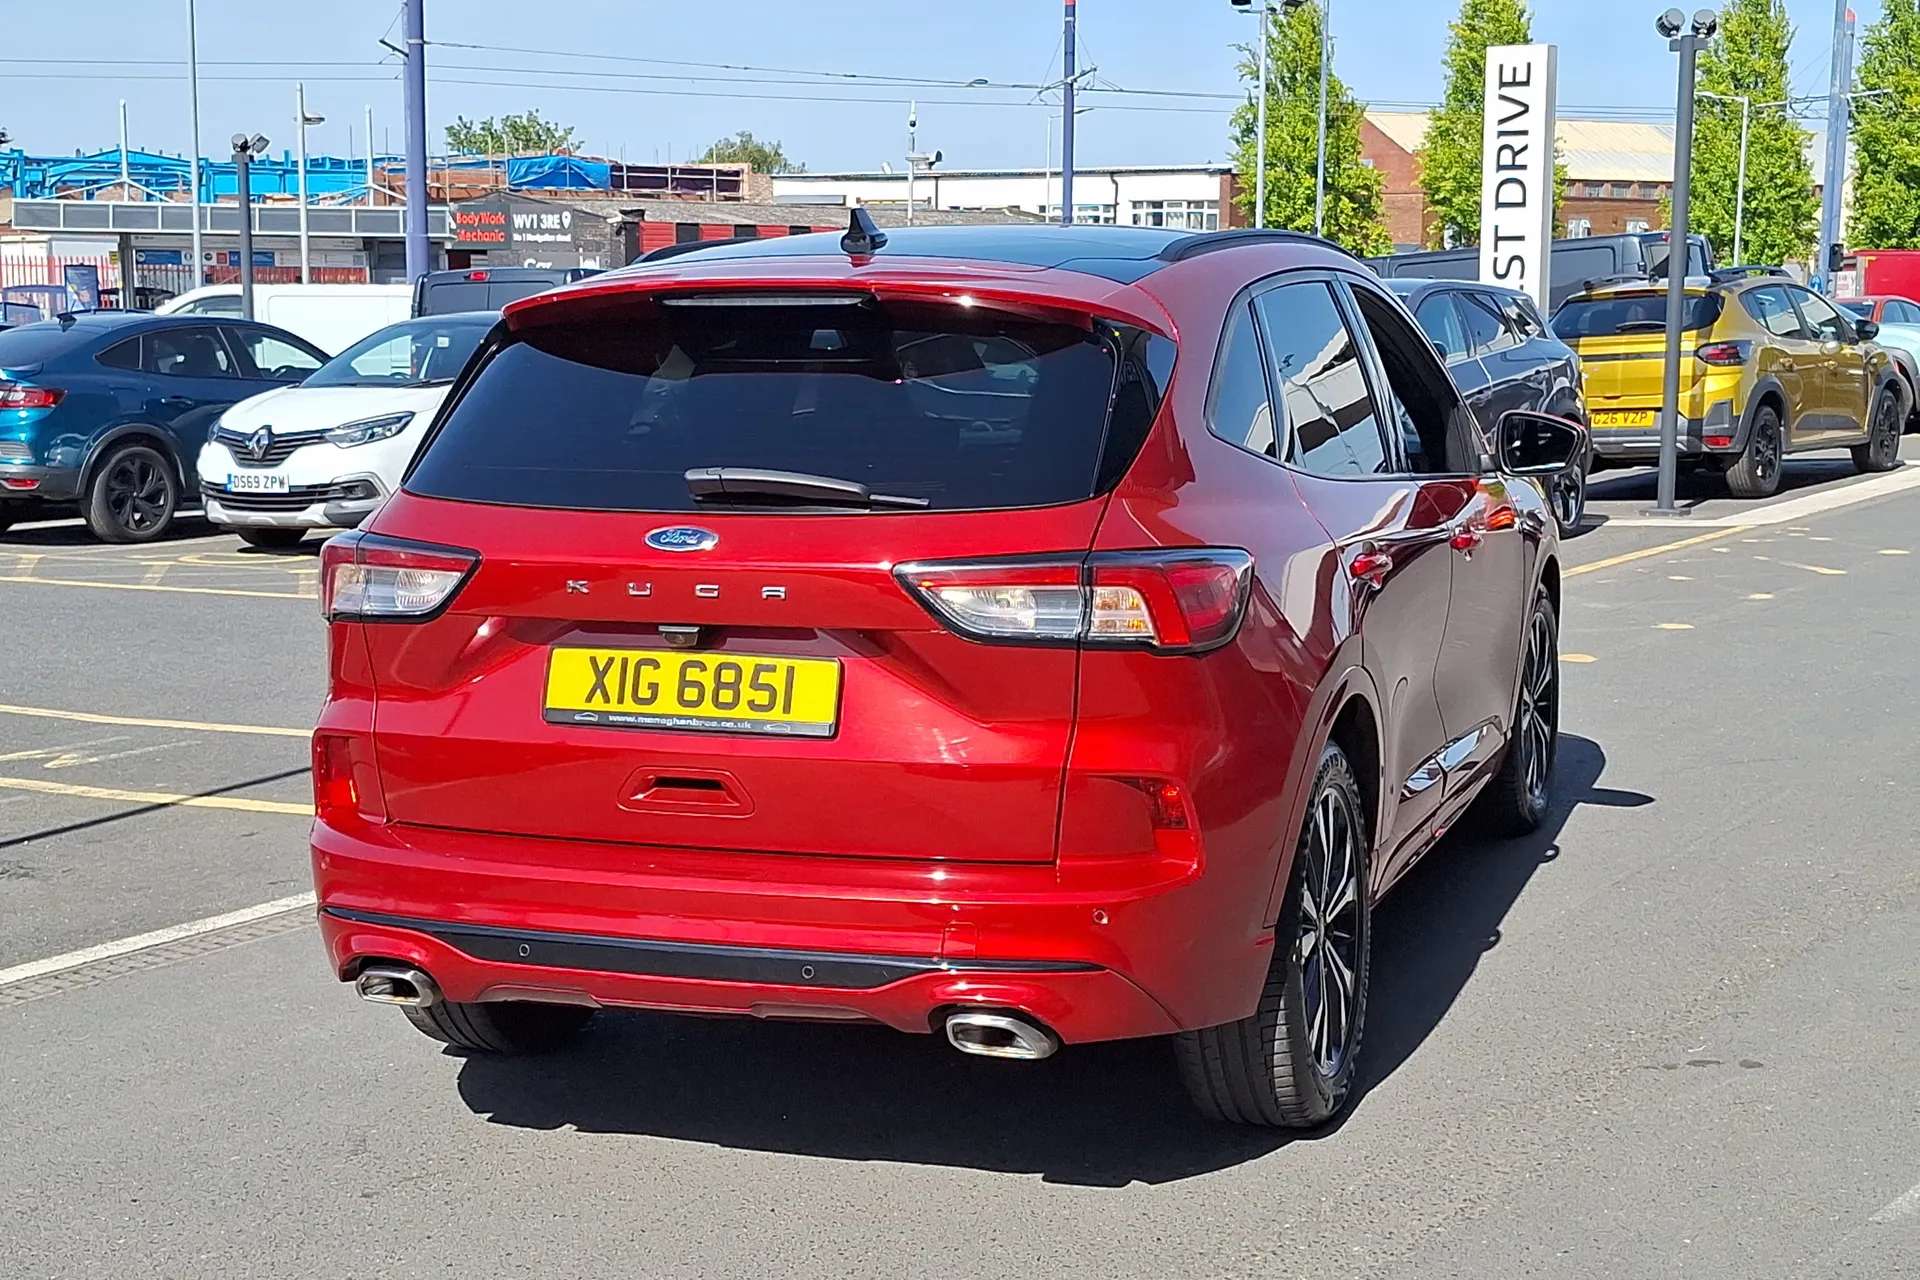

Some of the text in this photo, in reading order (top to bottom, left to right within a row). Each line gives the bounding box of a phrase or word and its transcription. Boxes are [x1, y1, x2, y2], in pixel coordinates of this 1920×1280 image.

[1493, 62, 1531, 291] ST DRIVE
[513, 214, 560, 229] WV1 3RE
[233, 475, 260, 489] DS69
[660, 529, 701, 543] Ford
[566, 579, 787, 600] KUGA
[585, 656, 795, 714] XIG 6851
